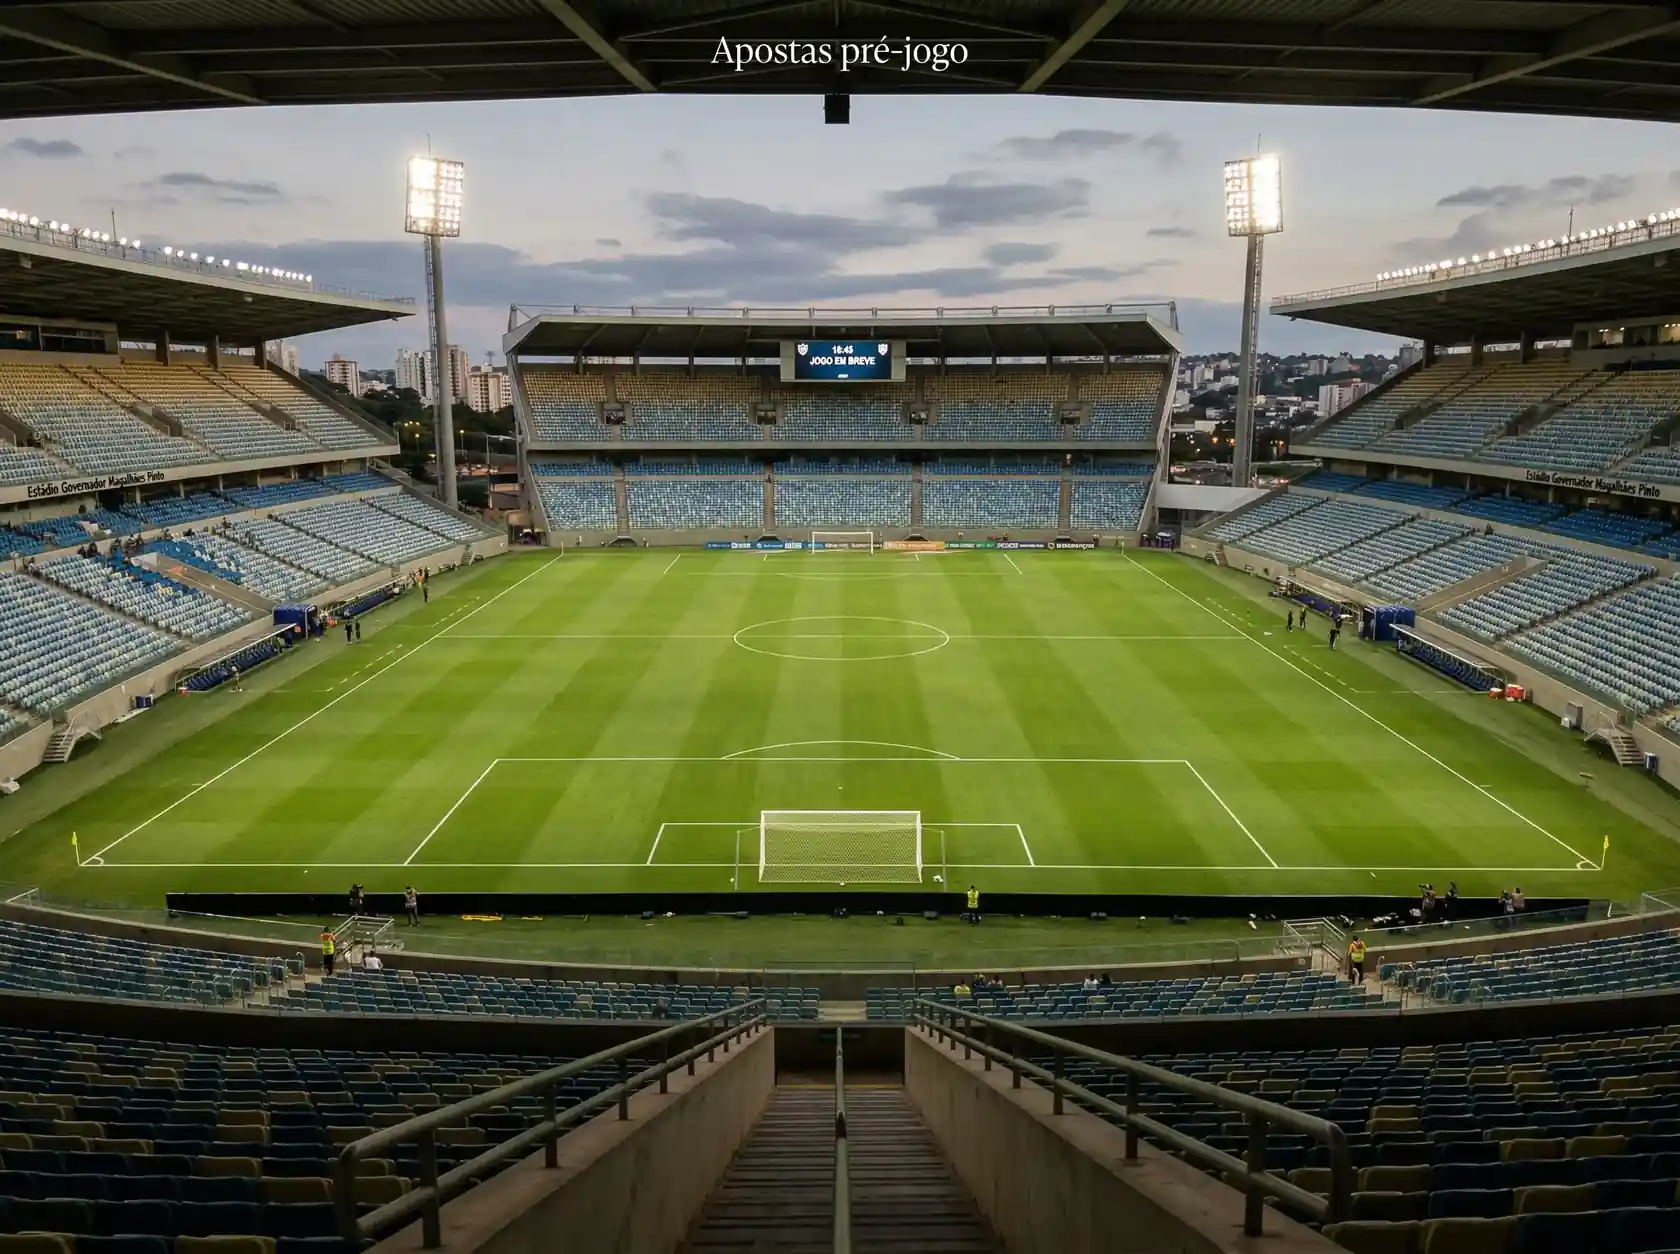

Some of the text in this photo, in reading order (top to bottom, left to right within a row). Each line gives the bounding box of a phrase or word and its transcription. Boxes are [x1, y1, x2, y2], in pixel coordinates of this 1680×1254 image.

[809, 356, 833, 366] JOGO
[847, 356, 876, 366] BREVE
[27, 471, 165, 498] Estádio Governador Magalhães Pinto
[1552, 471, 1594, 488] Governador
[1638, 483, 1661, 498] Pinto
